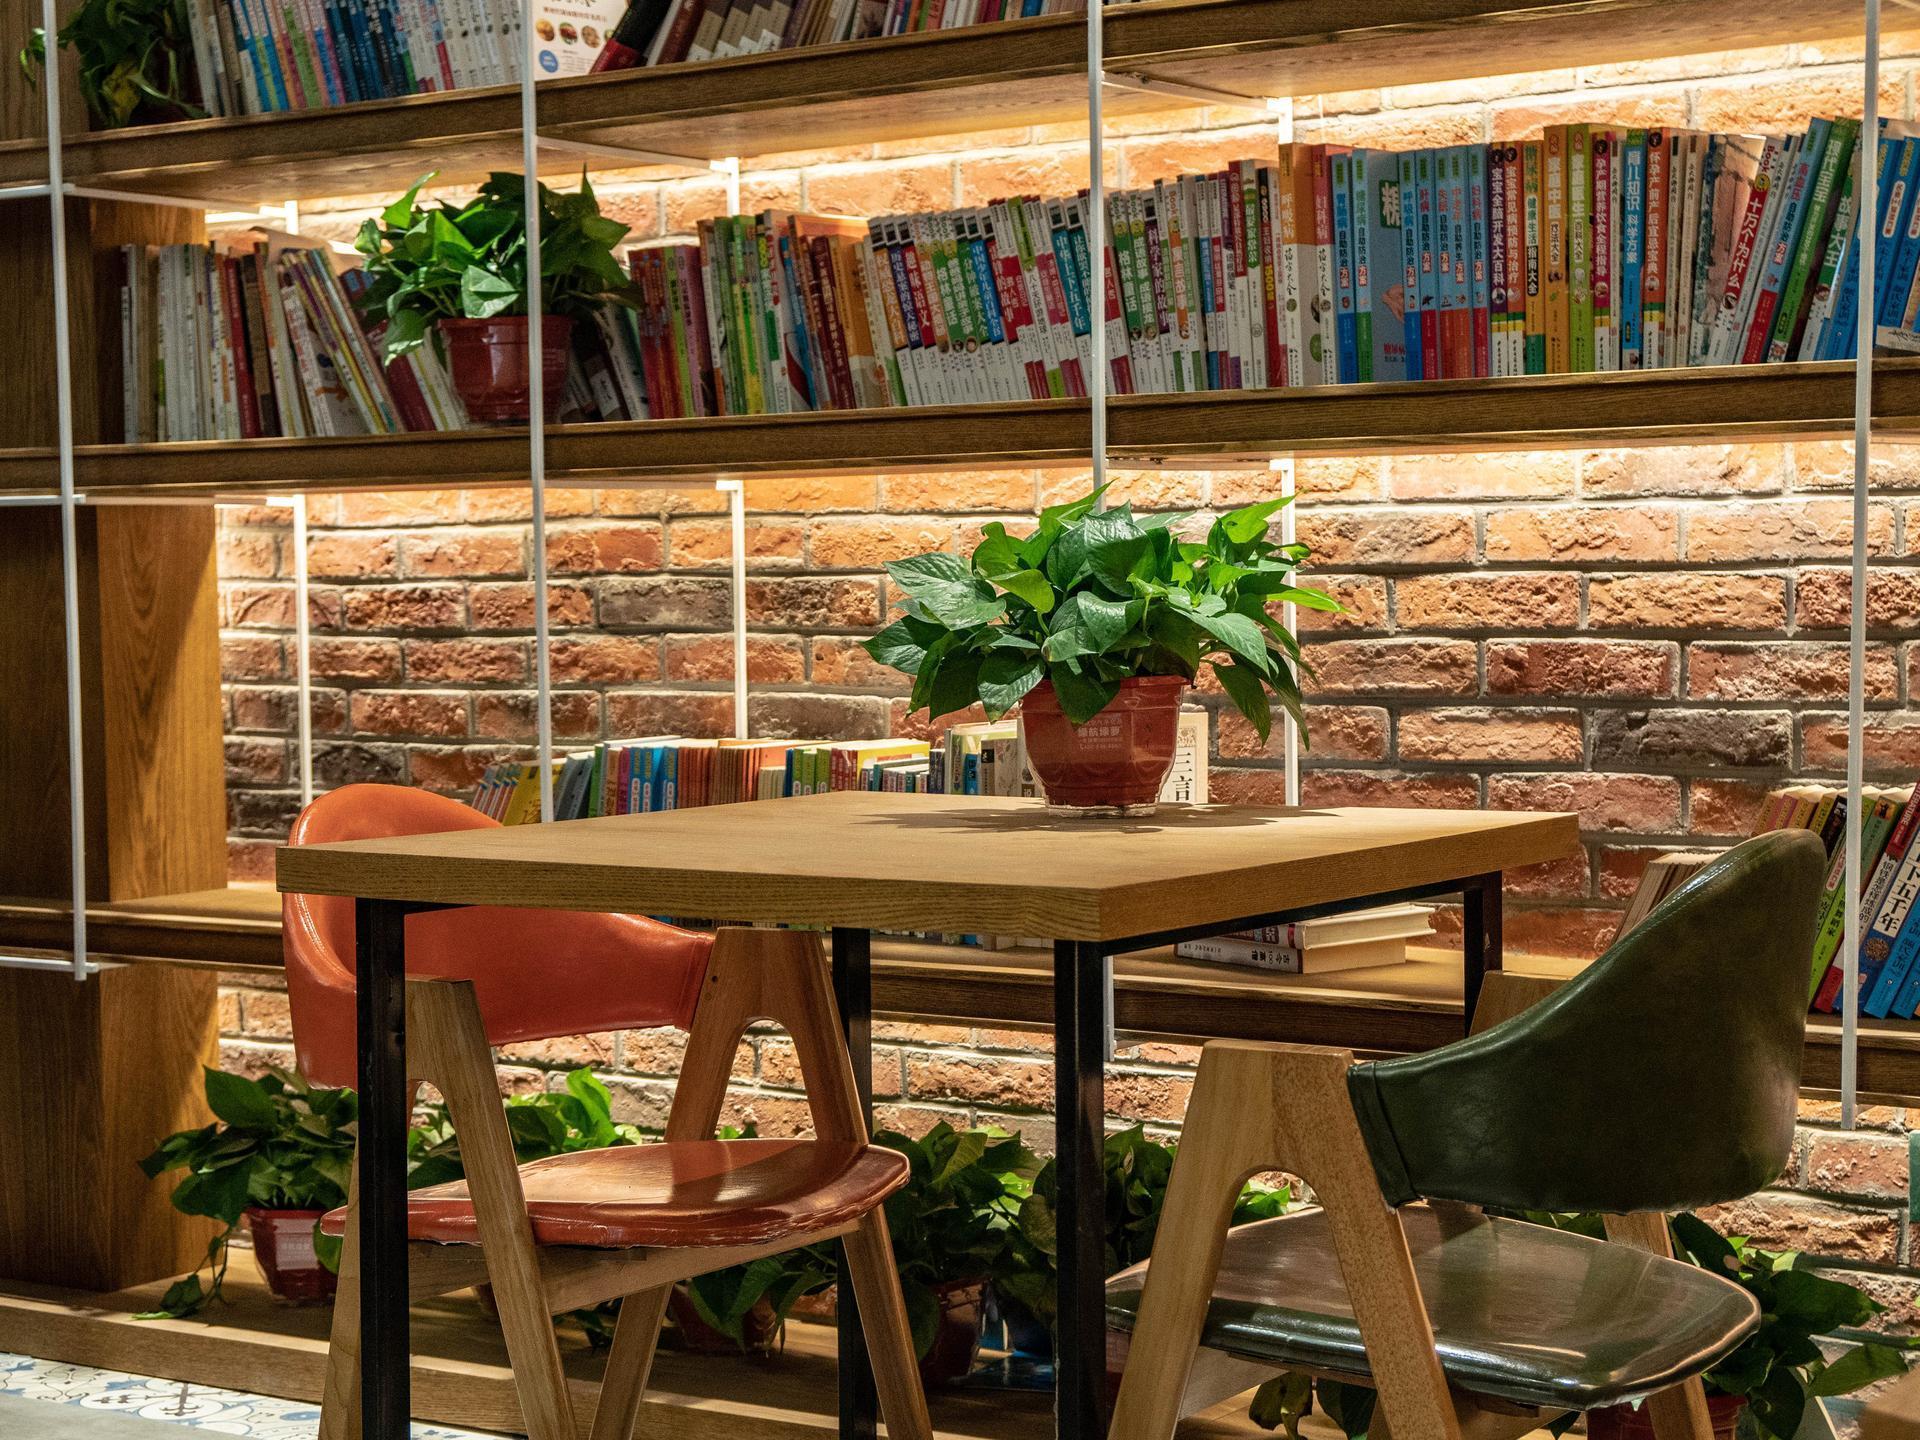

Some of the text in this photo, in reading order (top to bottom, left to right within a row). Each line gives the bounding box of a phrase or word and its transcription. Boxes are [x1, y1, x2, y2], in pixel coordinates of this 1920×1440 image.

[1491, 167, 1506, 284] 宝宝全脑开发大百科
[1505, 166, 1520, 283] 宝宝常见病预防与治疗
[1571, 156, 1585, 216] 家庭医生
[1725, 197, 1762, 289] 十万个为什么
[1823, 196, 1850, 268] 故事大王
[1056, 238, 1083, 330] 中华上下五千年
[1118, 250, 1137, 312] 格林童话
[1858, 860, 1893, 923] 钢铁是怎样炼成的
